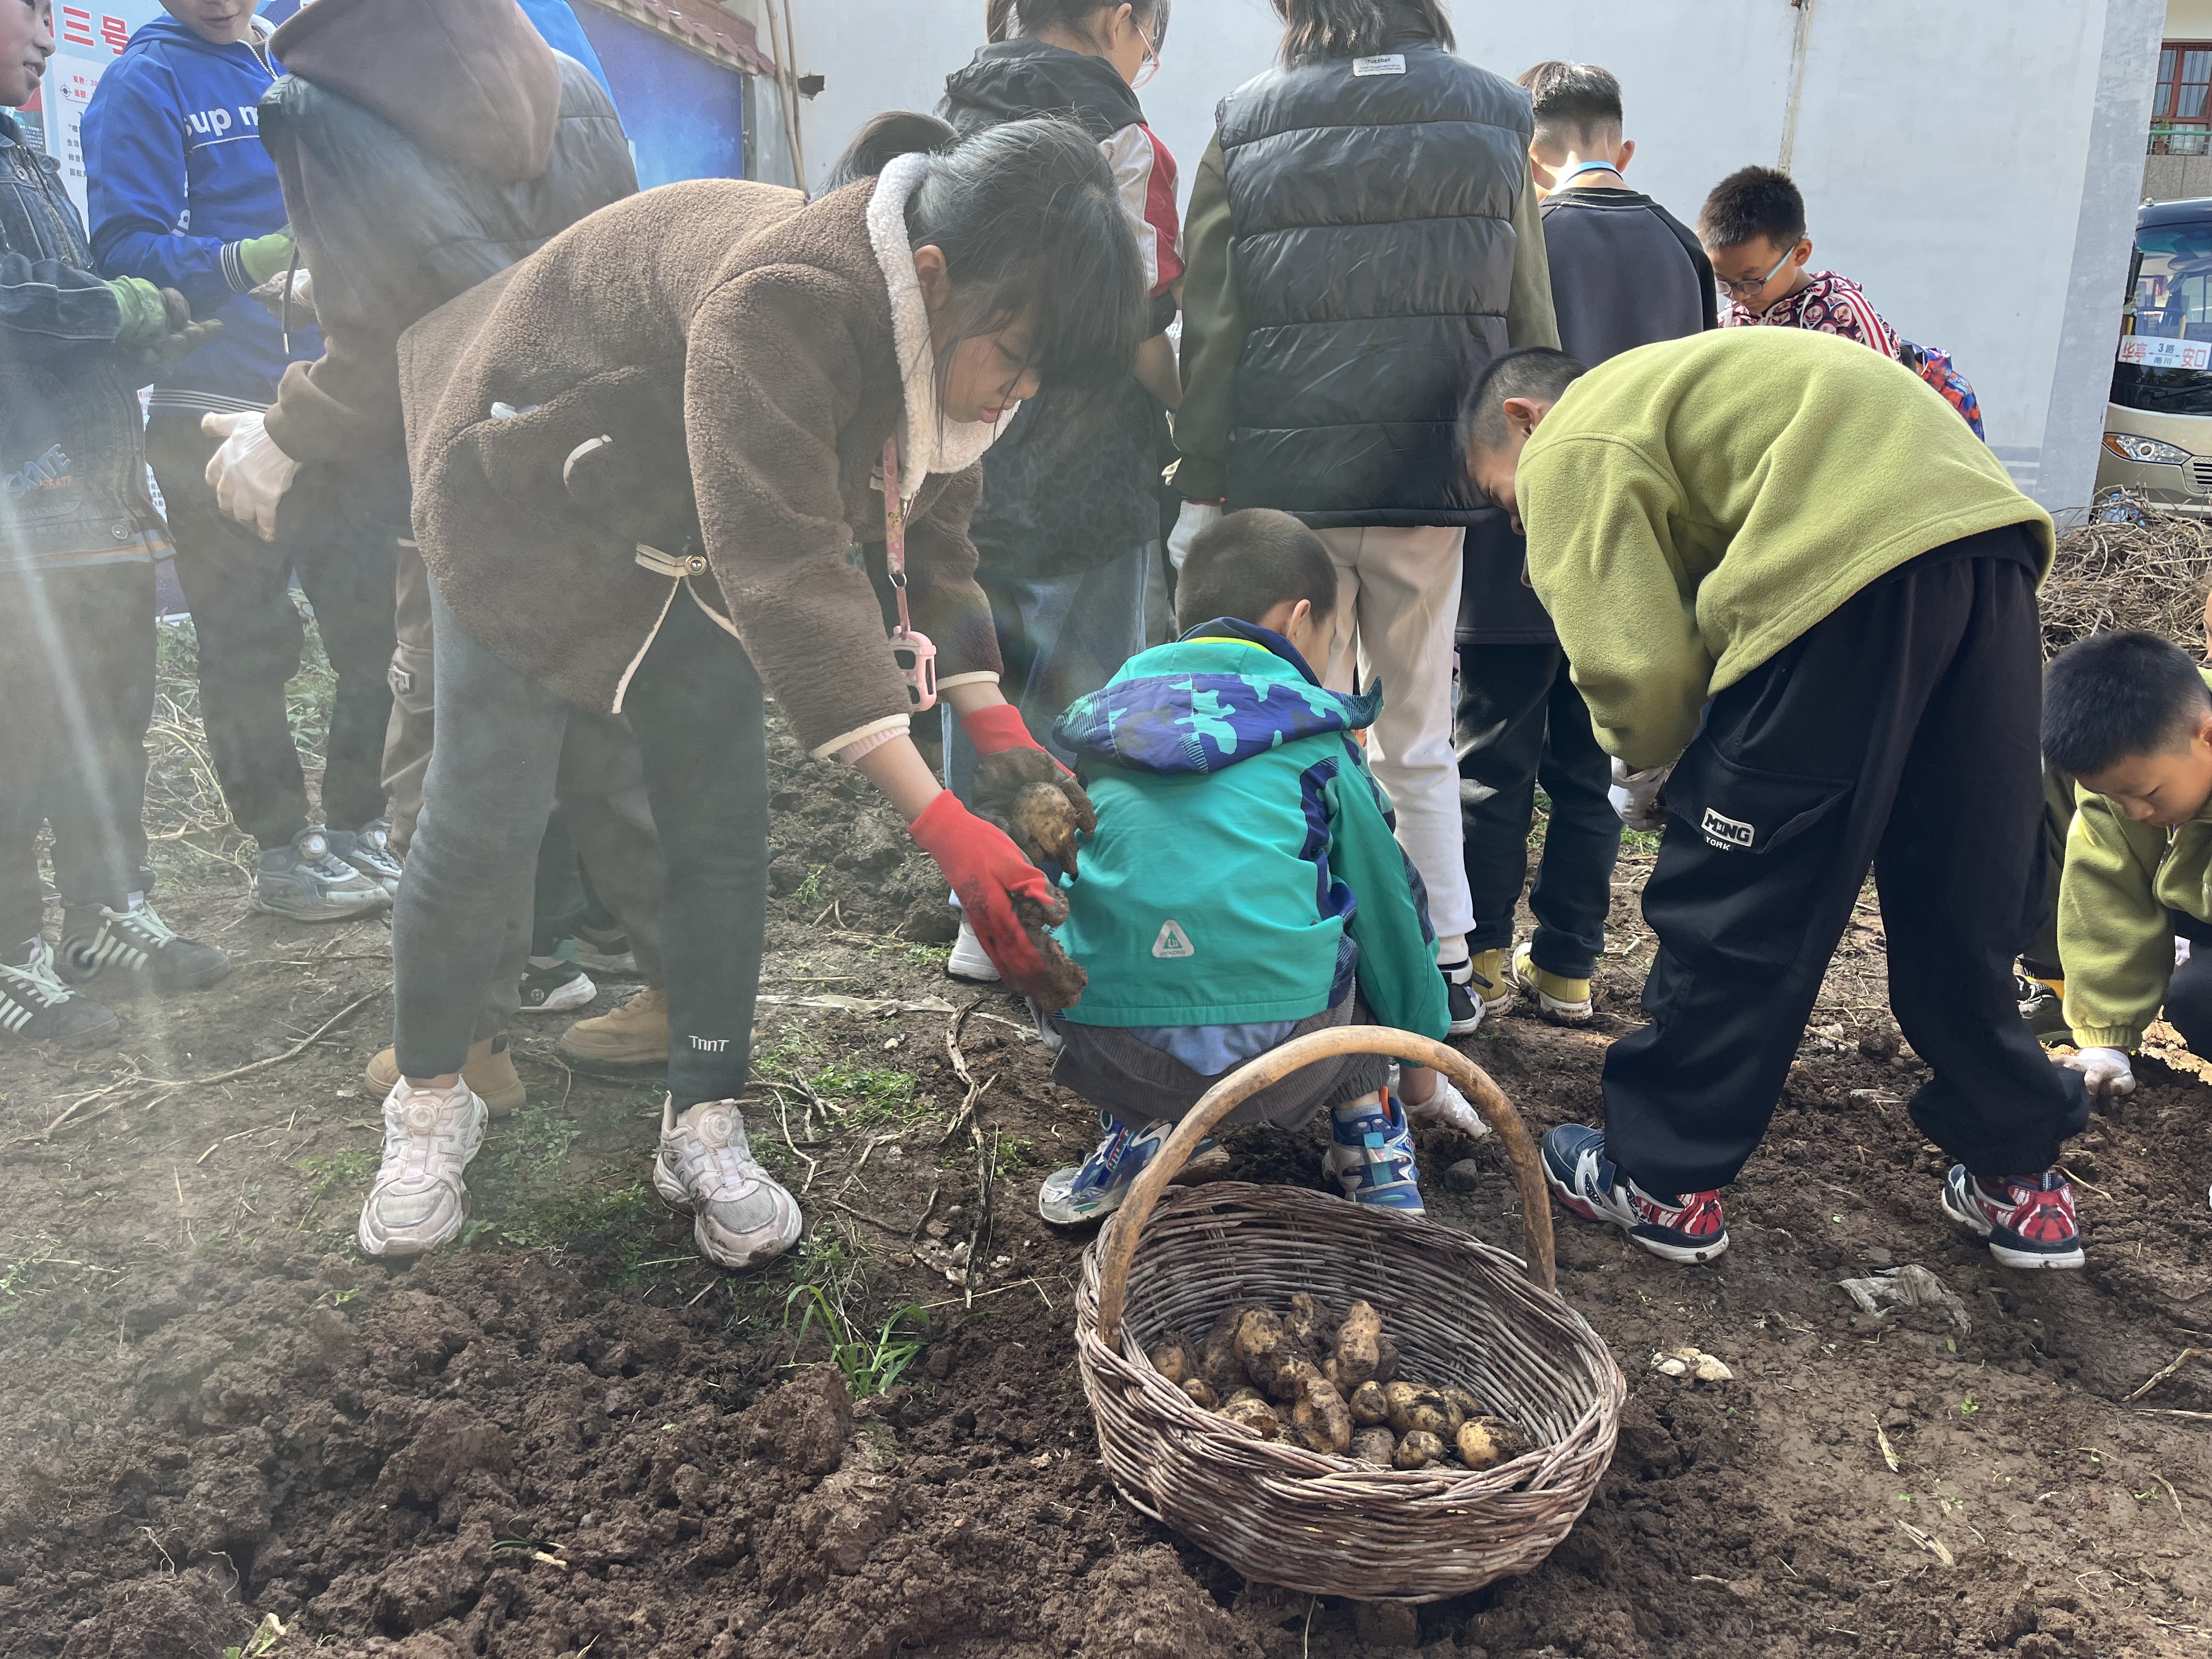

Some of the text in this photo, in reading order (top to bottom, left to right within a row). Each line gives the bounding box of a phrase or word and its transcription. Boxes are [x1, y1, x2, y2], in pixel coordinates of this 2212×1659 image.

[49, 6, 129, 55] 三号
[2123, 341, 2148, 363] 华亭
[2158, 343, 2175, 354] 3路
[2181, 346, 2207, 368] 安口
[2154, 357, 2172, 366] 南川
[2, 443, 71, 500] SKATE
[1706, 836, 1731, 851] YORK
[689, 1035, 730, 1052] TnnT
